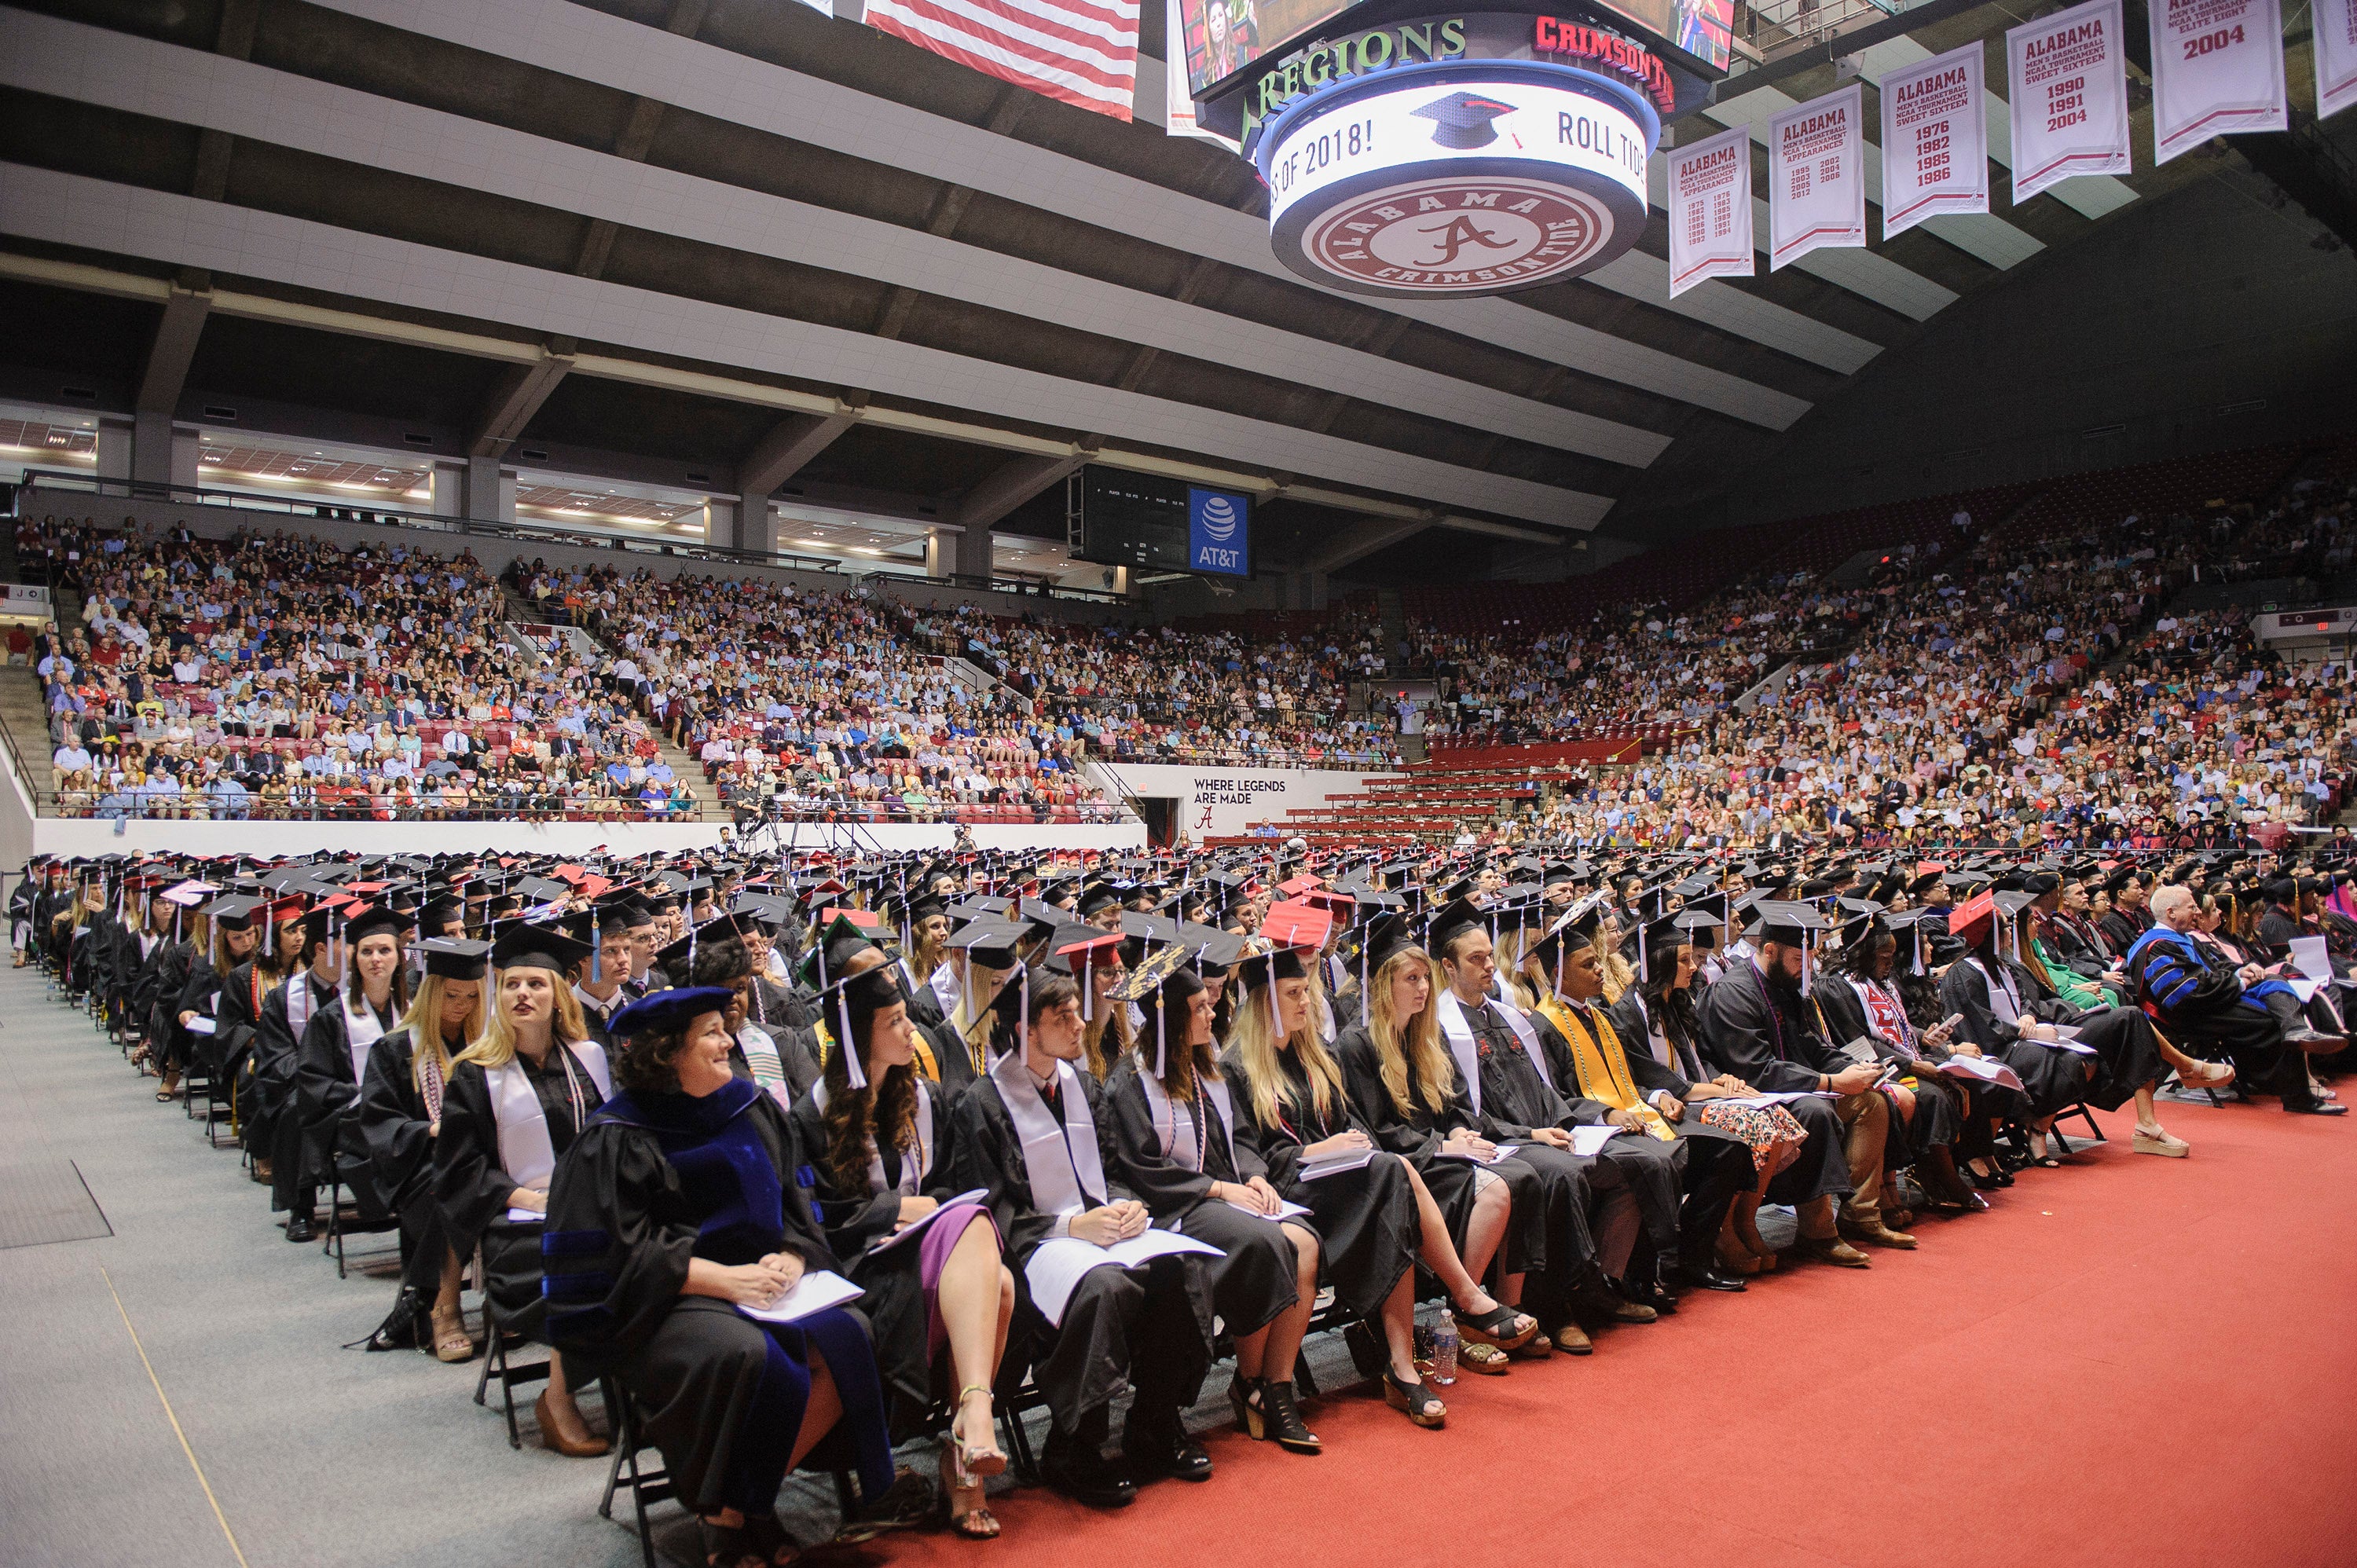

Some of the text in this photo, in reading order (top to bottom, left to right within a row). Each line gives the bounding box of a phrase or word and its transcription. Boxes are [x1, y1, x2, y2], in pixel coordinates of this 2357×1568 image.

[2168, 6, 2196, 20] MEN'S
[2168, 16, 2192, 28] NCAA
[2179, 16, 2211, 34] ELITE
[2214, 5, 2247, 23] EIGHT
[1536, 16, 1651, 79] CRIMSON
[2025, 19, 2104, 60] ALABAMA
[2183, 24, 2245, 60] 2004
[2025, 38, 2105, 69] MEN'S BASKETBALL
[2025, 45, 2106, 77] NCAA TOURNAMENT
[1257, 18, 1466, 121] REGIONS
[2025, 53, 2106, 85] SWEET SIXTEEN
[1897, 66, 1967, 104] ALABAMA
[2047, 76, 2085, 99] 1990
[1896, 85, 1968, 112] MEN'S BASKETBALL
[1896, 91, 1968, 119] NCAA TOURNAMENT
[2047, 93, 2084, 115] 1991
[1783, 108, 1846, 142] ALABAMA
[1896, 98, 1968, 127] SWEET SIXTEEN
[2047, 108, 2088, 132] 2004
[1783, 125, 1847, 151] MEN'S BASKETBALL
[1915, 119, 1950, 141] 1976
[1281, 151, 1299, 192] OF
[1306, 119, 1372, 176] 2018!
[1559, 111, 1615, 160] ROLL
[1783, 131, 1847, 157] NCAA TOURNAMENT
[1787, 138, 1844, 164] APPEARANCES
[1915, 135, 1950, 156] 1982
[1680, 161, 1737, 186] MEN'S BASKETBALL
[1681, 145, 1736, 178] ALABAMA
[1791, 156, 1840, 178] 1995 2002
[1791, 163, 1840, 185] 2003 2004
[1916, 151, 1951, 172] 1985
[1680, 167, 1738, 192] NCAA TOURNAMENT
[1683, 174, 1735, 198] APPEARANCES
[1791, 171, 1840, 192] 2005 2006
[1917, 167, 1951, 187] 1986
[1791, 189, 1811, 200] 2012
[1332, 192, 1542, 261] ALABAMA
[1373, 217, 1580, 284] CRIMSON TIDE
[1199, 546, 1240, 568] AT&T
[1194, 779, 1286, 793] WHERE LEGENDS
[1194, 793, 1252, 804] ARE MADE
[1193, 805, 1214, 830] A
